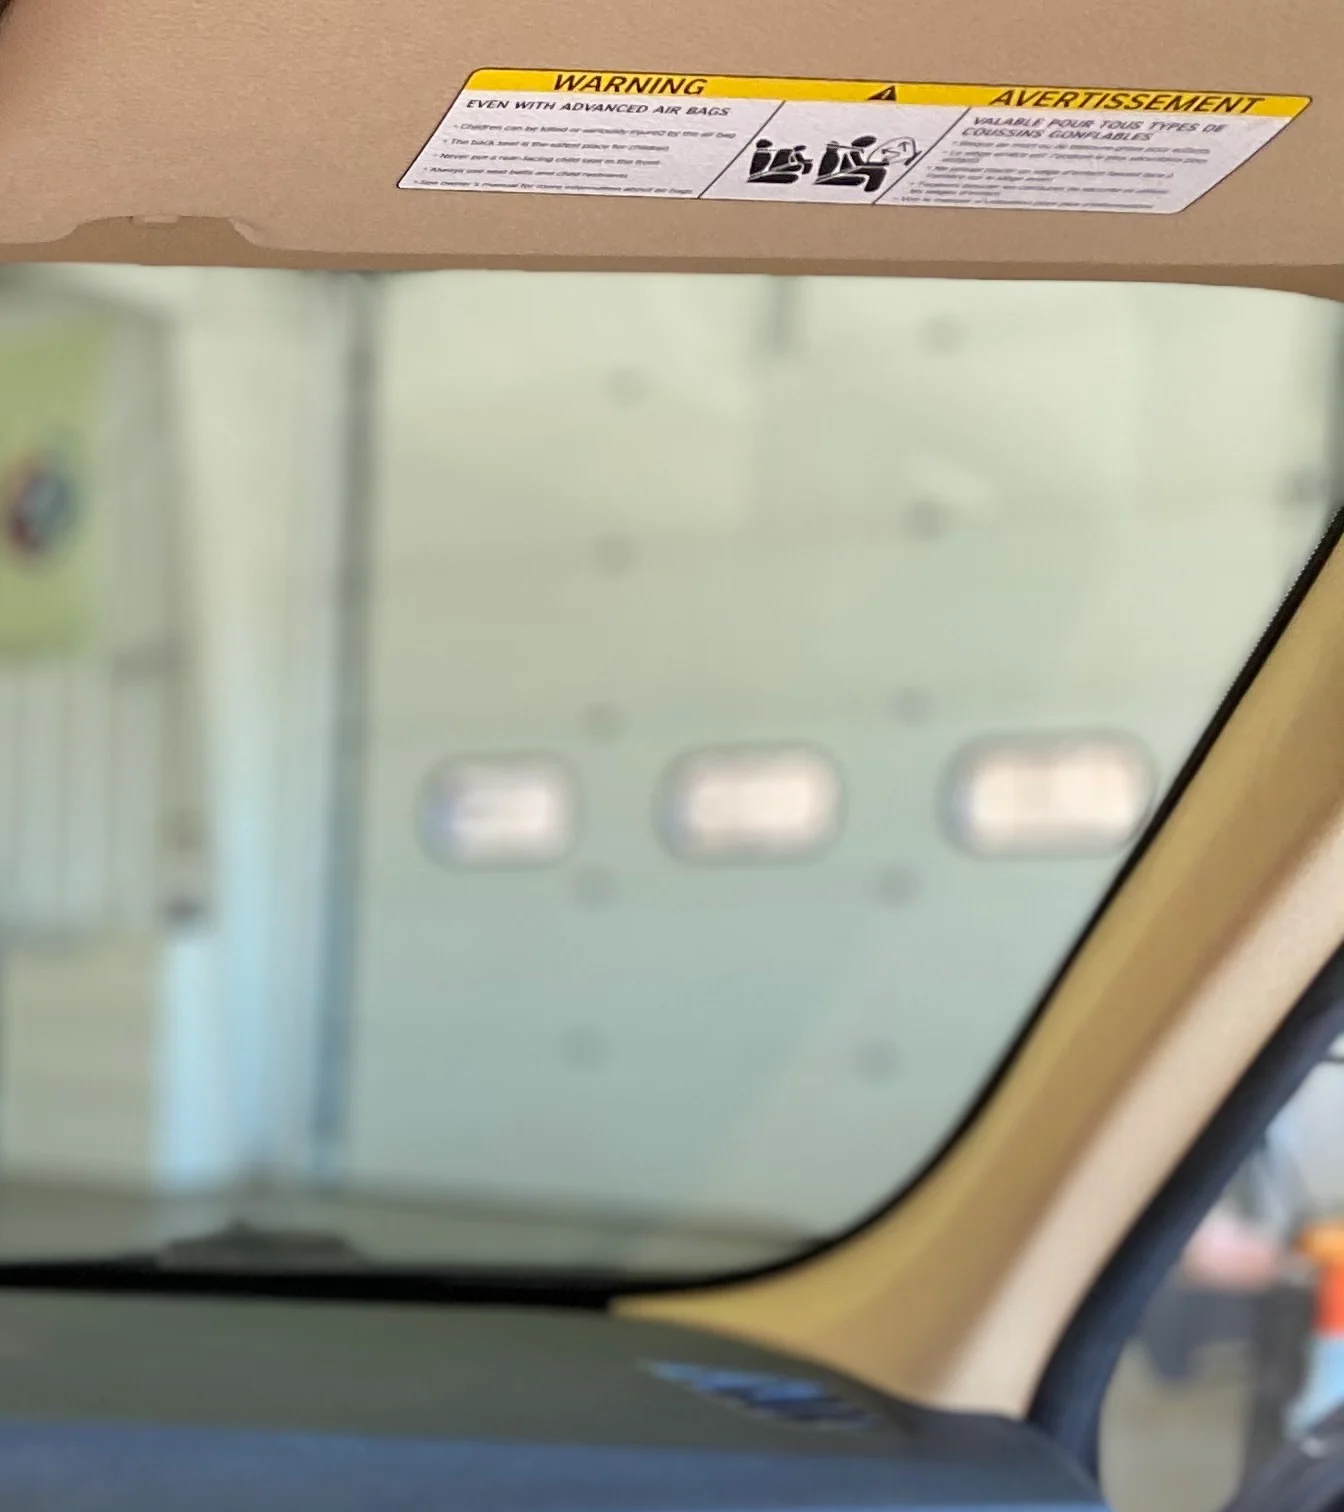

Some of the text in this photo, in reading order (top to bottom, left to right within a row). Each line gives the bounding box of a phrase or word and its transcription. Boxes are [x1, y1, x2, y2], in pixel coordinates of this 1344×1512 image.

[554, 74, 707, 96] WARNING
[466, 99, 731, 116] EVEN WITH ADVANCED AIR BAGS
[990, 89, 1266, 114] AVERTISSEMENT
[974, 117, 1229, 133] VALABLE POUR TOUS TYPES DE
[962, 127, 1154, 141] COUSSINS GONFLABLES
